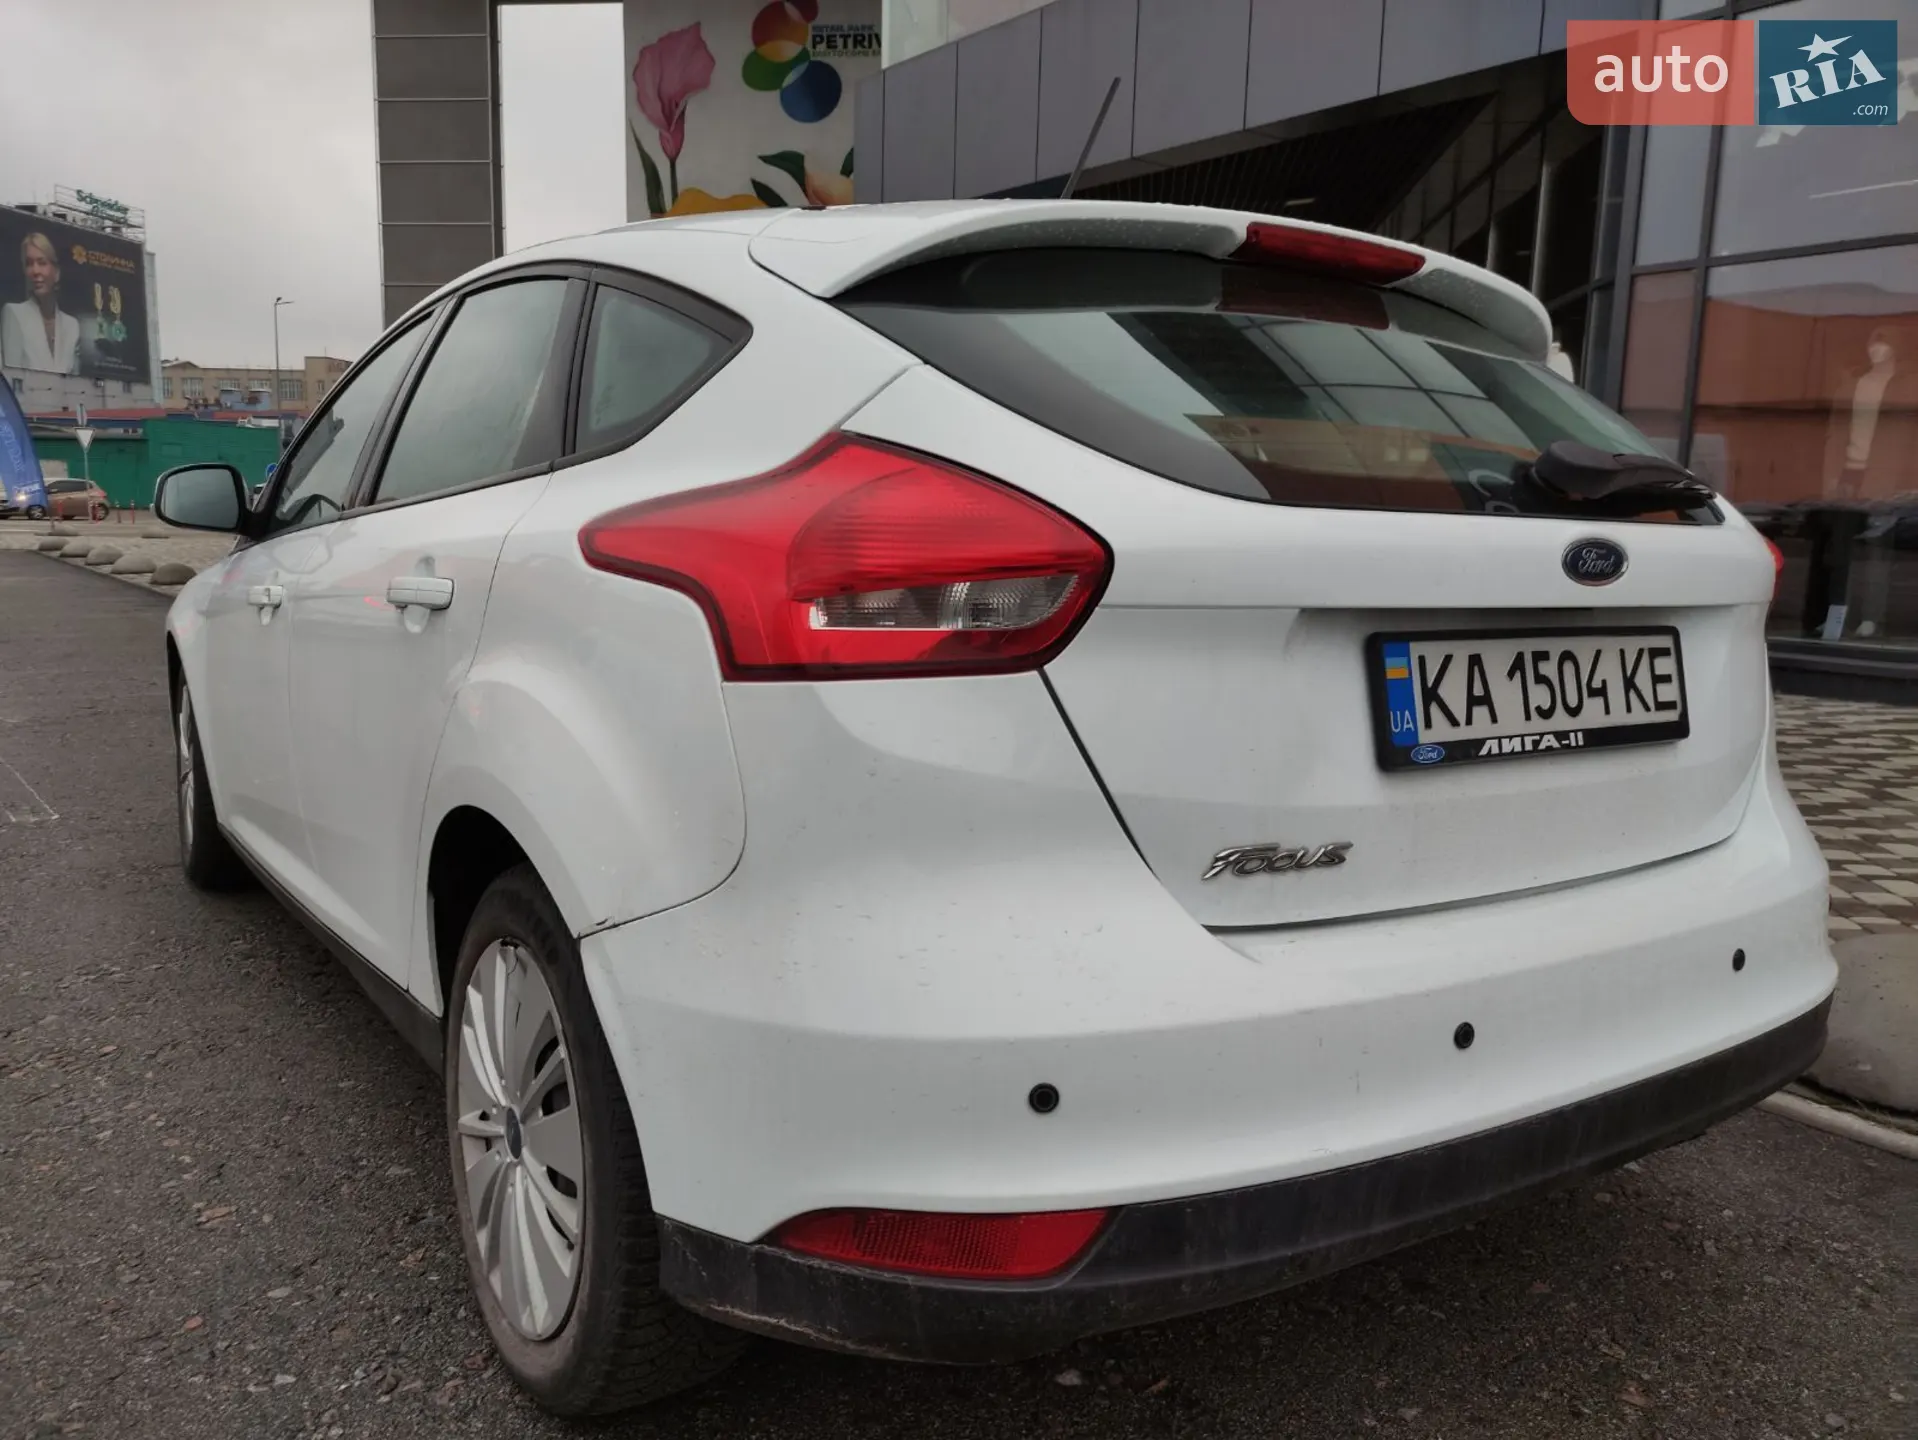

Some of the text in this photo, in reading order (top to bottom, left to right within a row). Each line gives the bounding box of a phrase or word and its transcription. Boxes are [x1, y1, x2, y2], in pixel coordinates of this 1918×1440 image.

[1578, 548, 1616, 573] Ford
[1418, 647, 1678, 730] KA 1504 KE
[1390, 710, 1415, 732] UA
